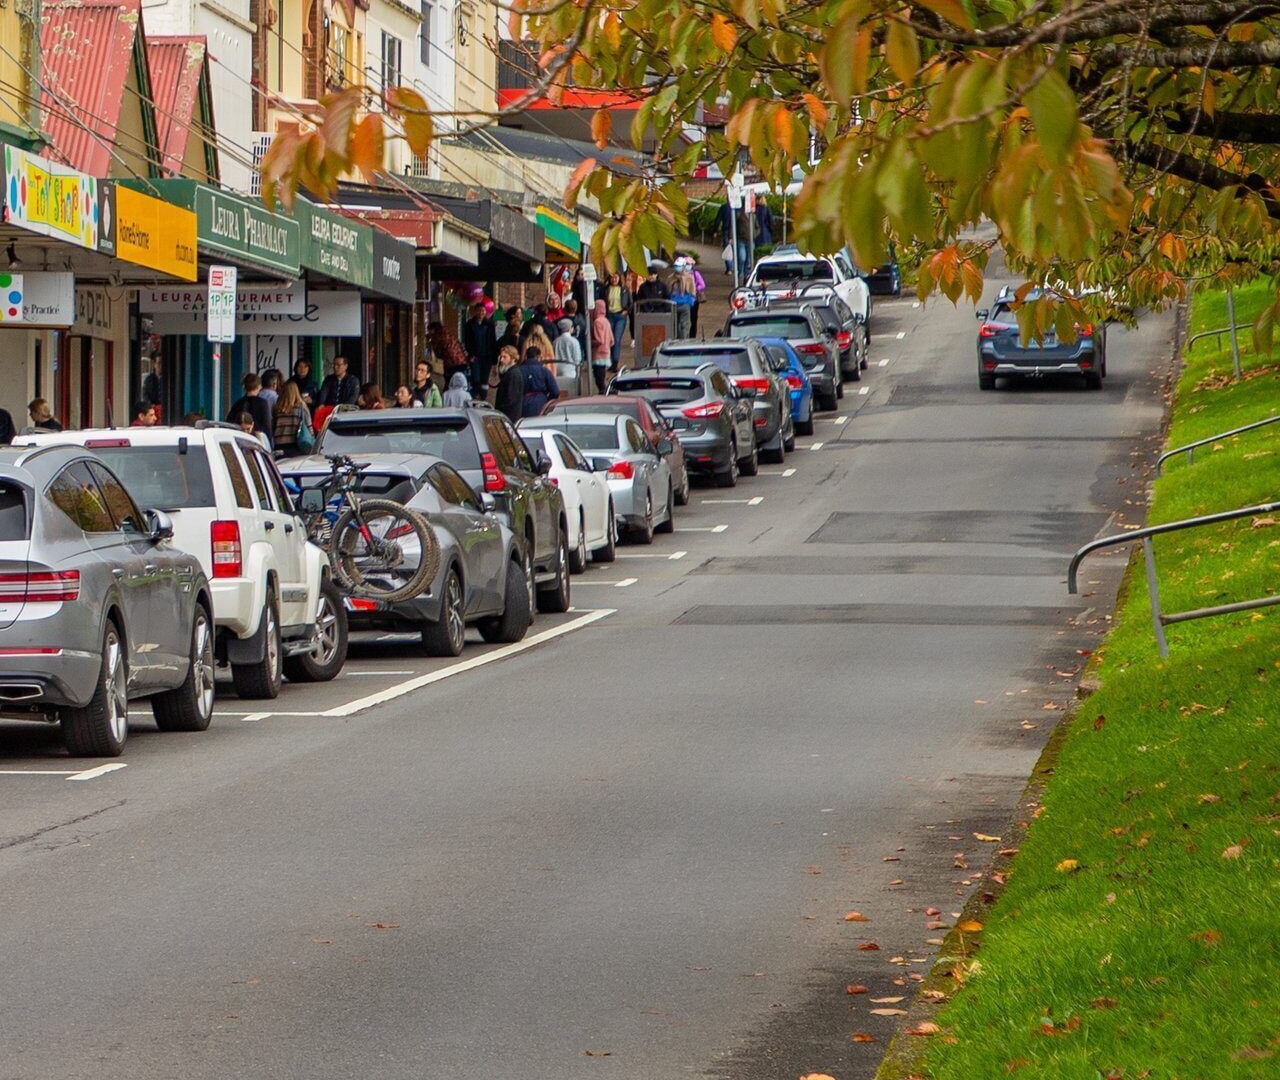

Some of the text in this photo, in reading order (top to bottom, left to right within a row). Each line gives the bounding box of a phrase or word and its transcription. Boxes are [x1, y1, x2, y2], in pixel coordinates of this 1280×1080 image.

[311, 214, 331, 242] LEURA
[86, 290, 112, 329] DELI
[151, 293, 294, 303] LEURA URMET
